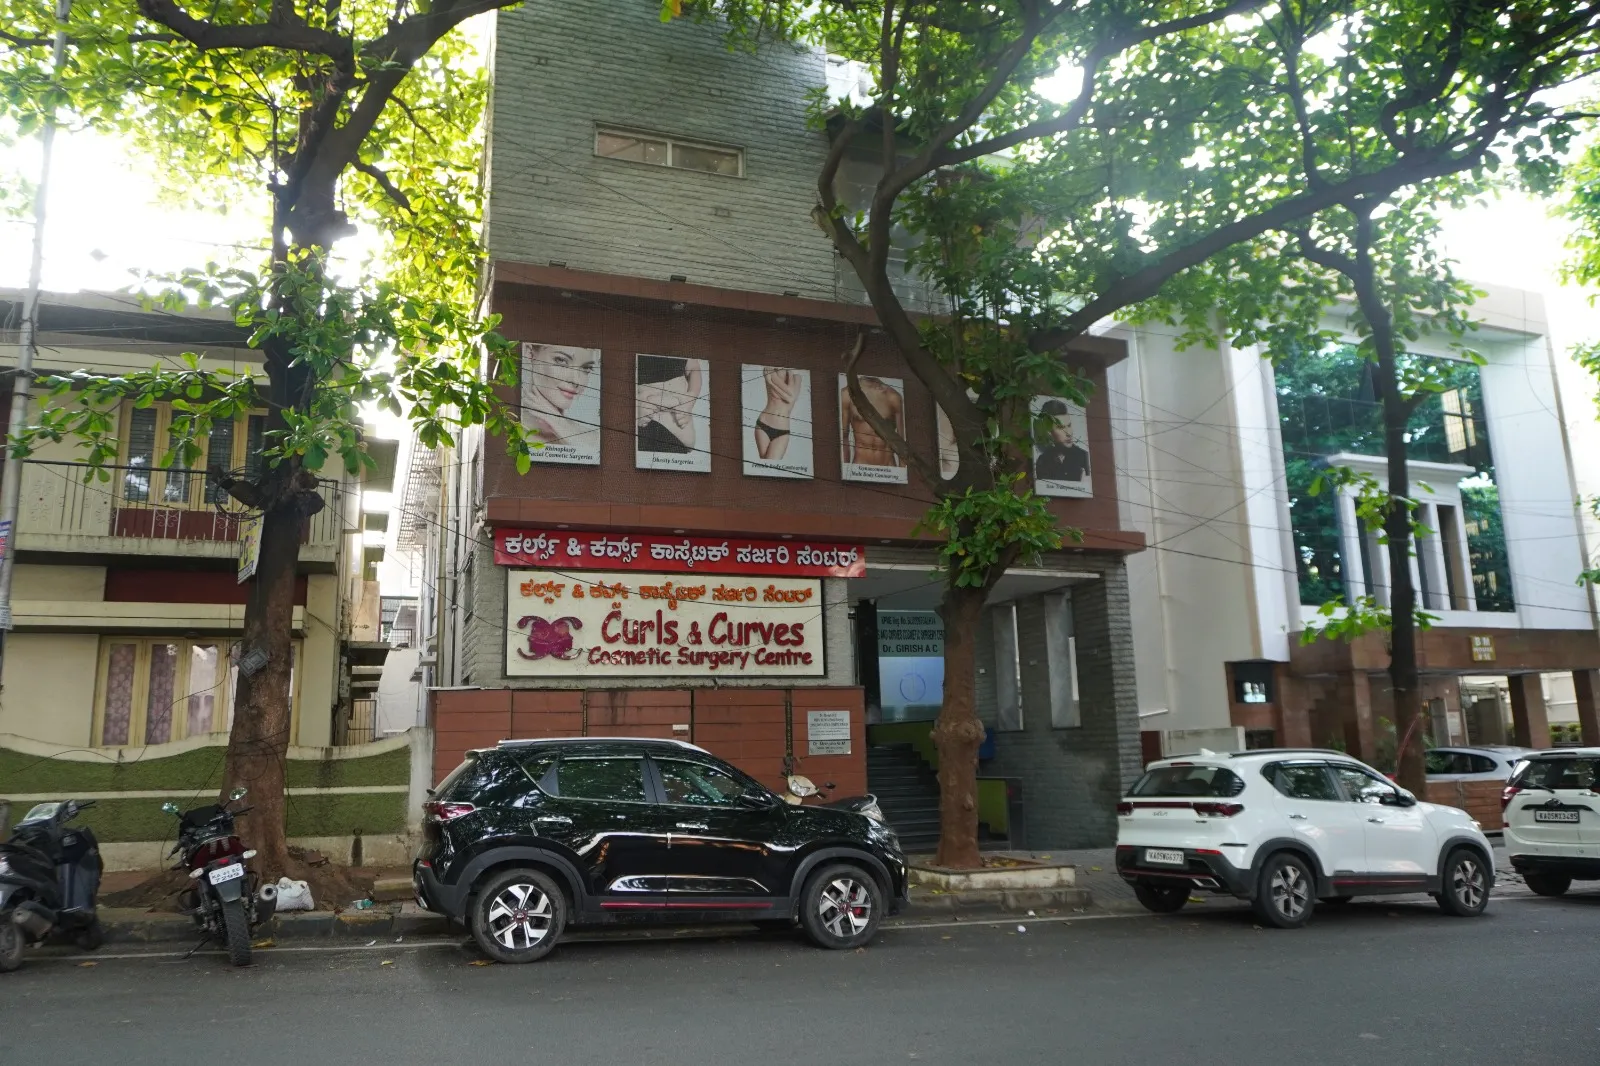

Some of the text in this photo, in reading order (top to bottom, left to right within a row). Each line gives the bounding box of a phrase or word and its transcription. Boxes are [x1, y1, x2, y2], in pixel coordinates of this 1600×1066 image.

[566, 537, 582, 556] &
[736, 544, 790, 564] ಸರ್ಜರಿ
[796, 545, 858, 567] ಸೆಂಟರ್
[572, 583, 585, 598] &
[763, 584, 813, 603] ಸೆಂಟರ್
[601, 610, 805, 646] Curls & Curves
[587, 646, 813, 671] Cosmetic Surgery Centre
[882, 644, 938, 653] Dr. GIRISH A C
